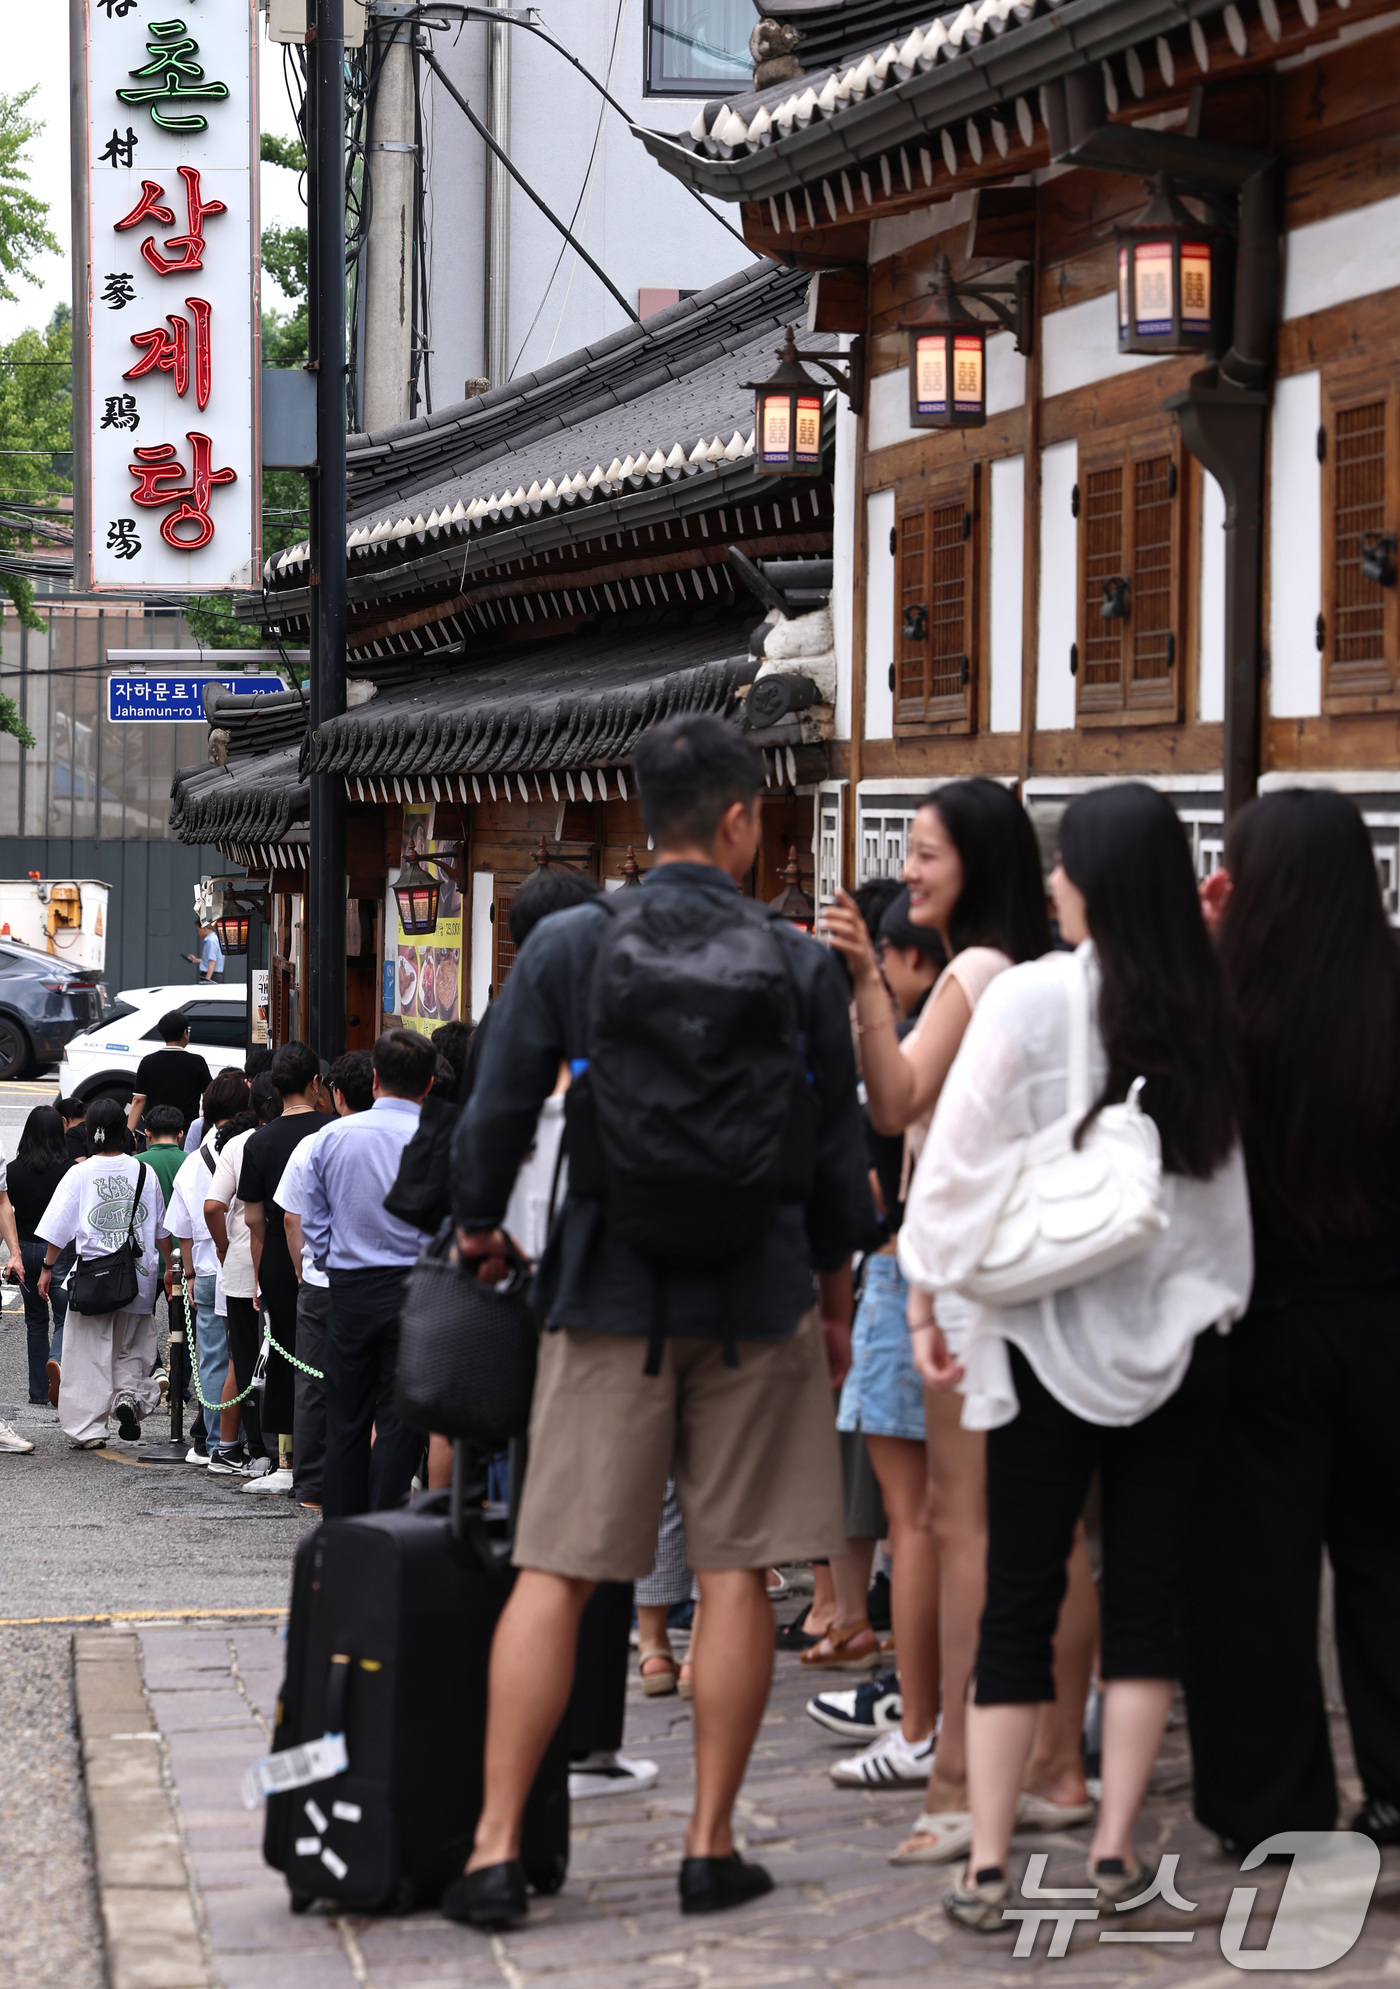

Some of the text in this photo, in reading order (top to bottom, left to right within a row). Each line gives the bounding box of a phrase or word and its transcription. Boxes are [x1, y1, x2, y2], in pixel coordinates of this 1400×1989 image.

[113, 18, 238, 552] 촌 삼계탕
[116, 682, 235, 702] 자하문로1
[116, 705, 192, 717] Jahamun-ro
